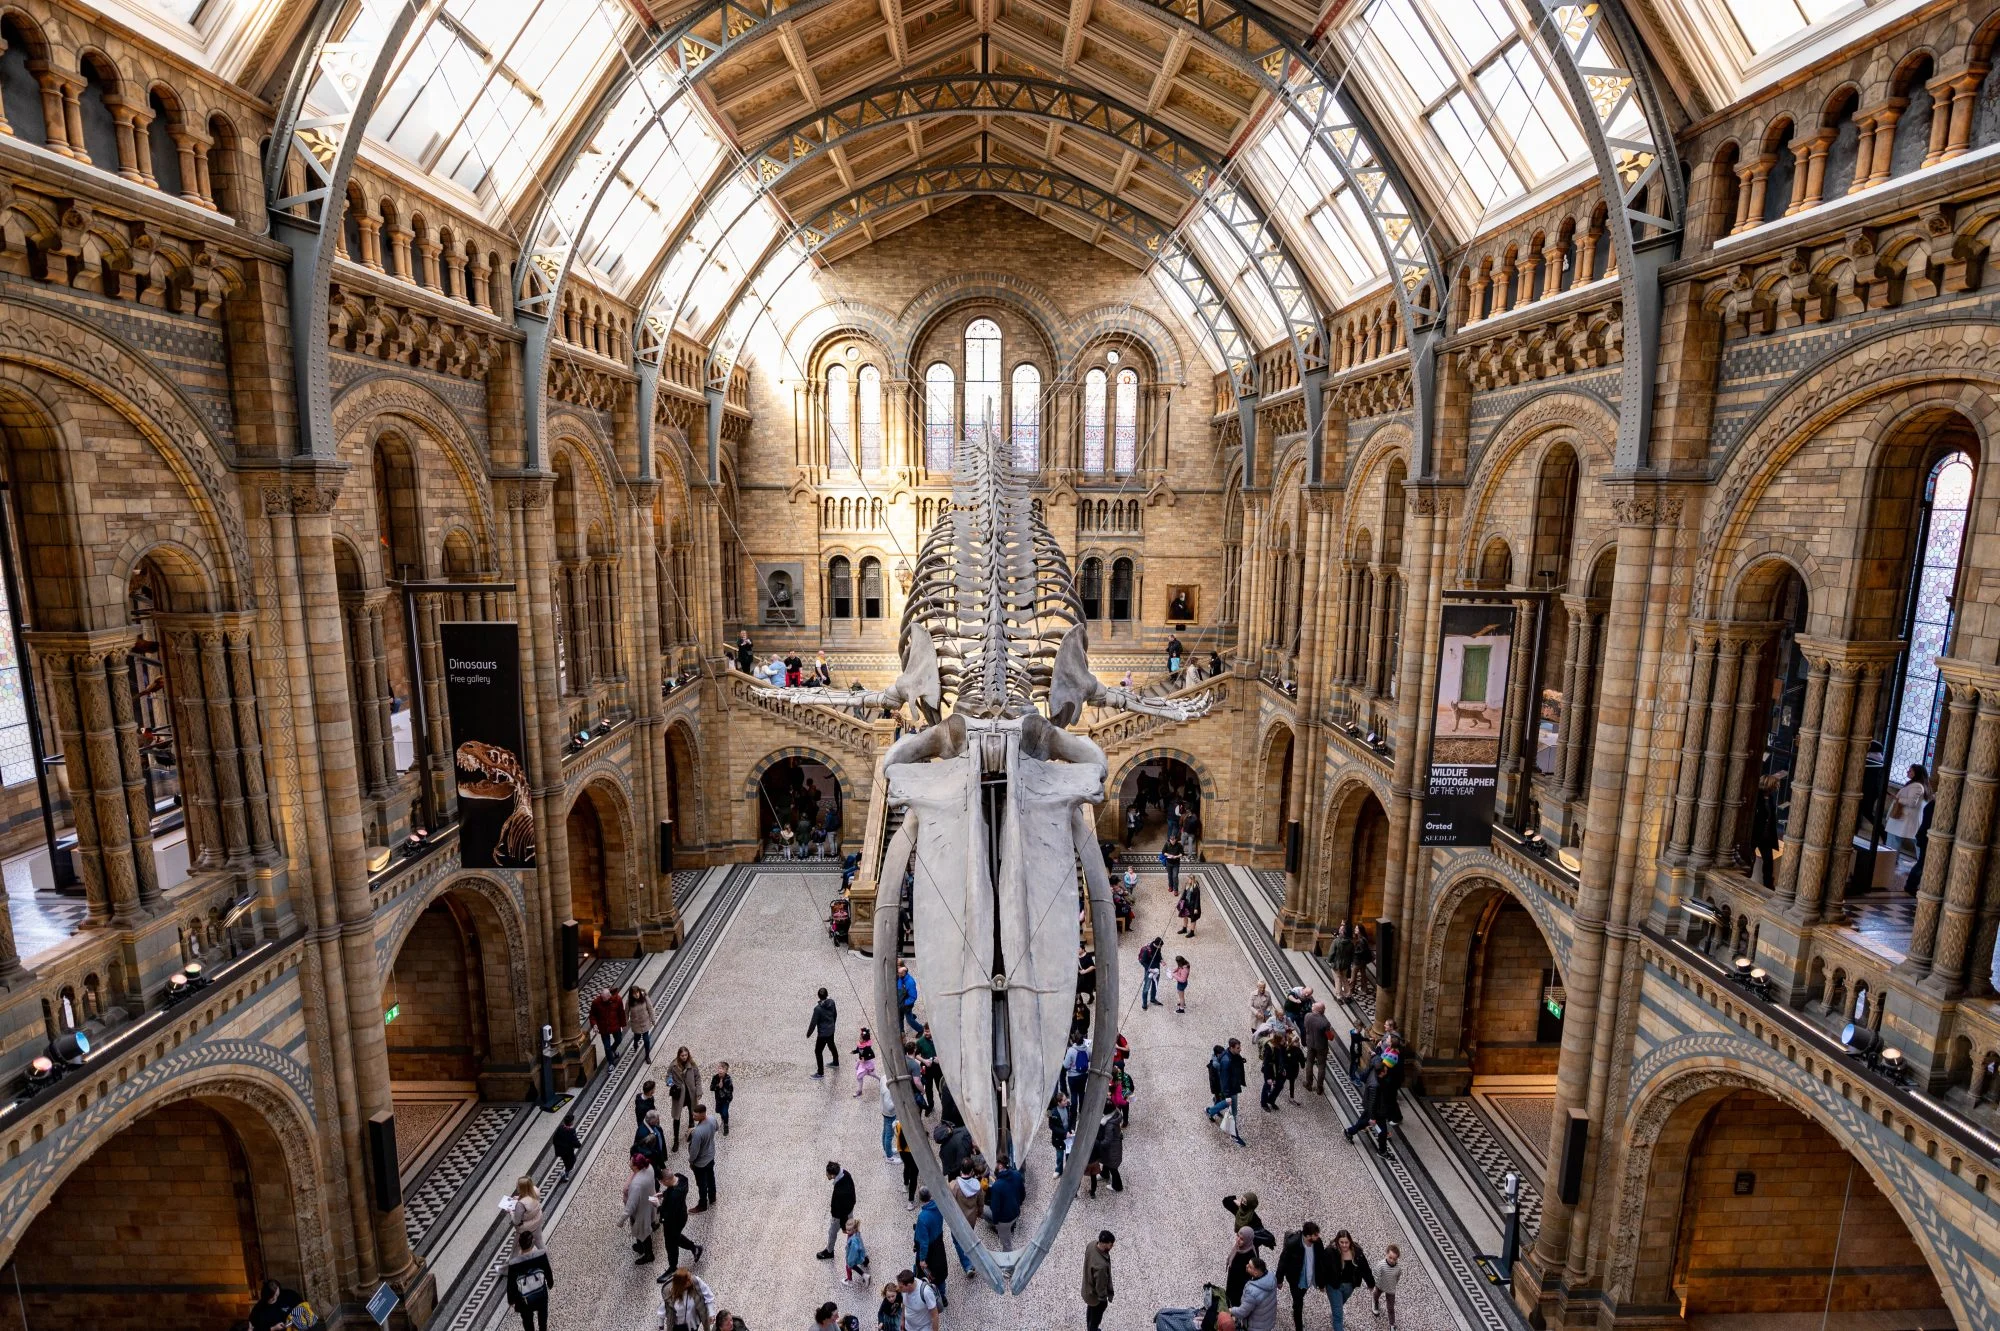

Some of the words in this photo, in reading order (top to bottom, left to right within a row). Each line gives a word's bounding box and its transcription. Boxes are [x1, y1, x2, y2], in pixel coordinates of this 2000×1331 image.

[449, 658, 497, 670] Dinosaurs
[450, 674, 466, 683] Free
[466, 674, 491, 685] gallery
[1431, 768, 1468, 777] WILDLIFE
[1430, 777, 1495, 787] PHOTOGRAPHER
[1429, 786, 1440, 795] OF
[1441, 786, 1455, 796] THE
[1456, 787, 1475, 796] YEAR
